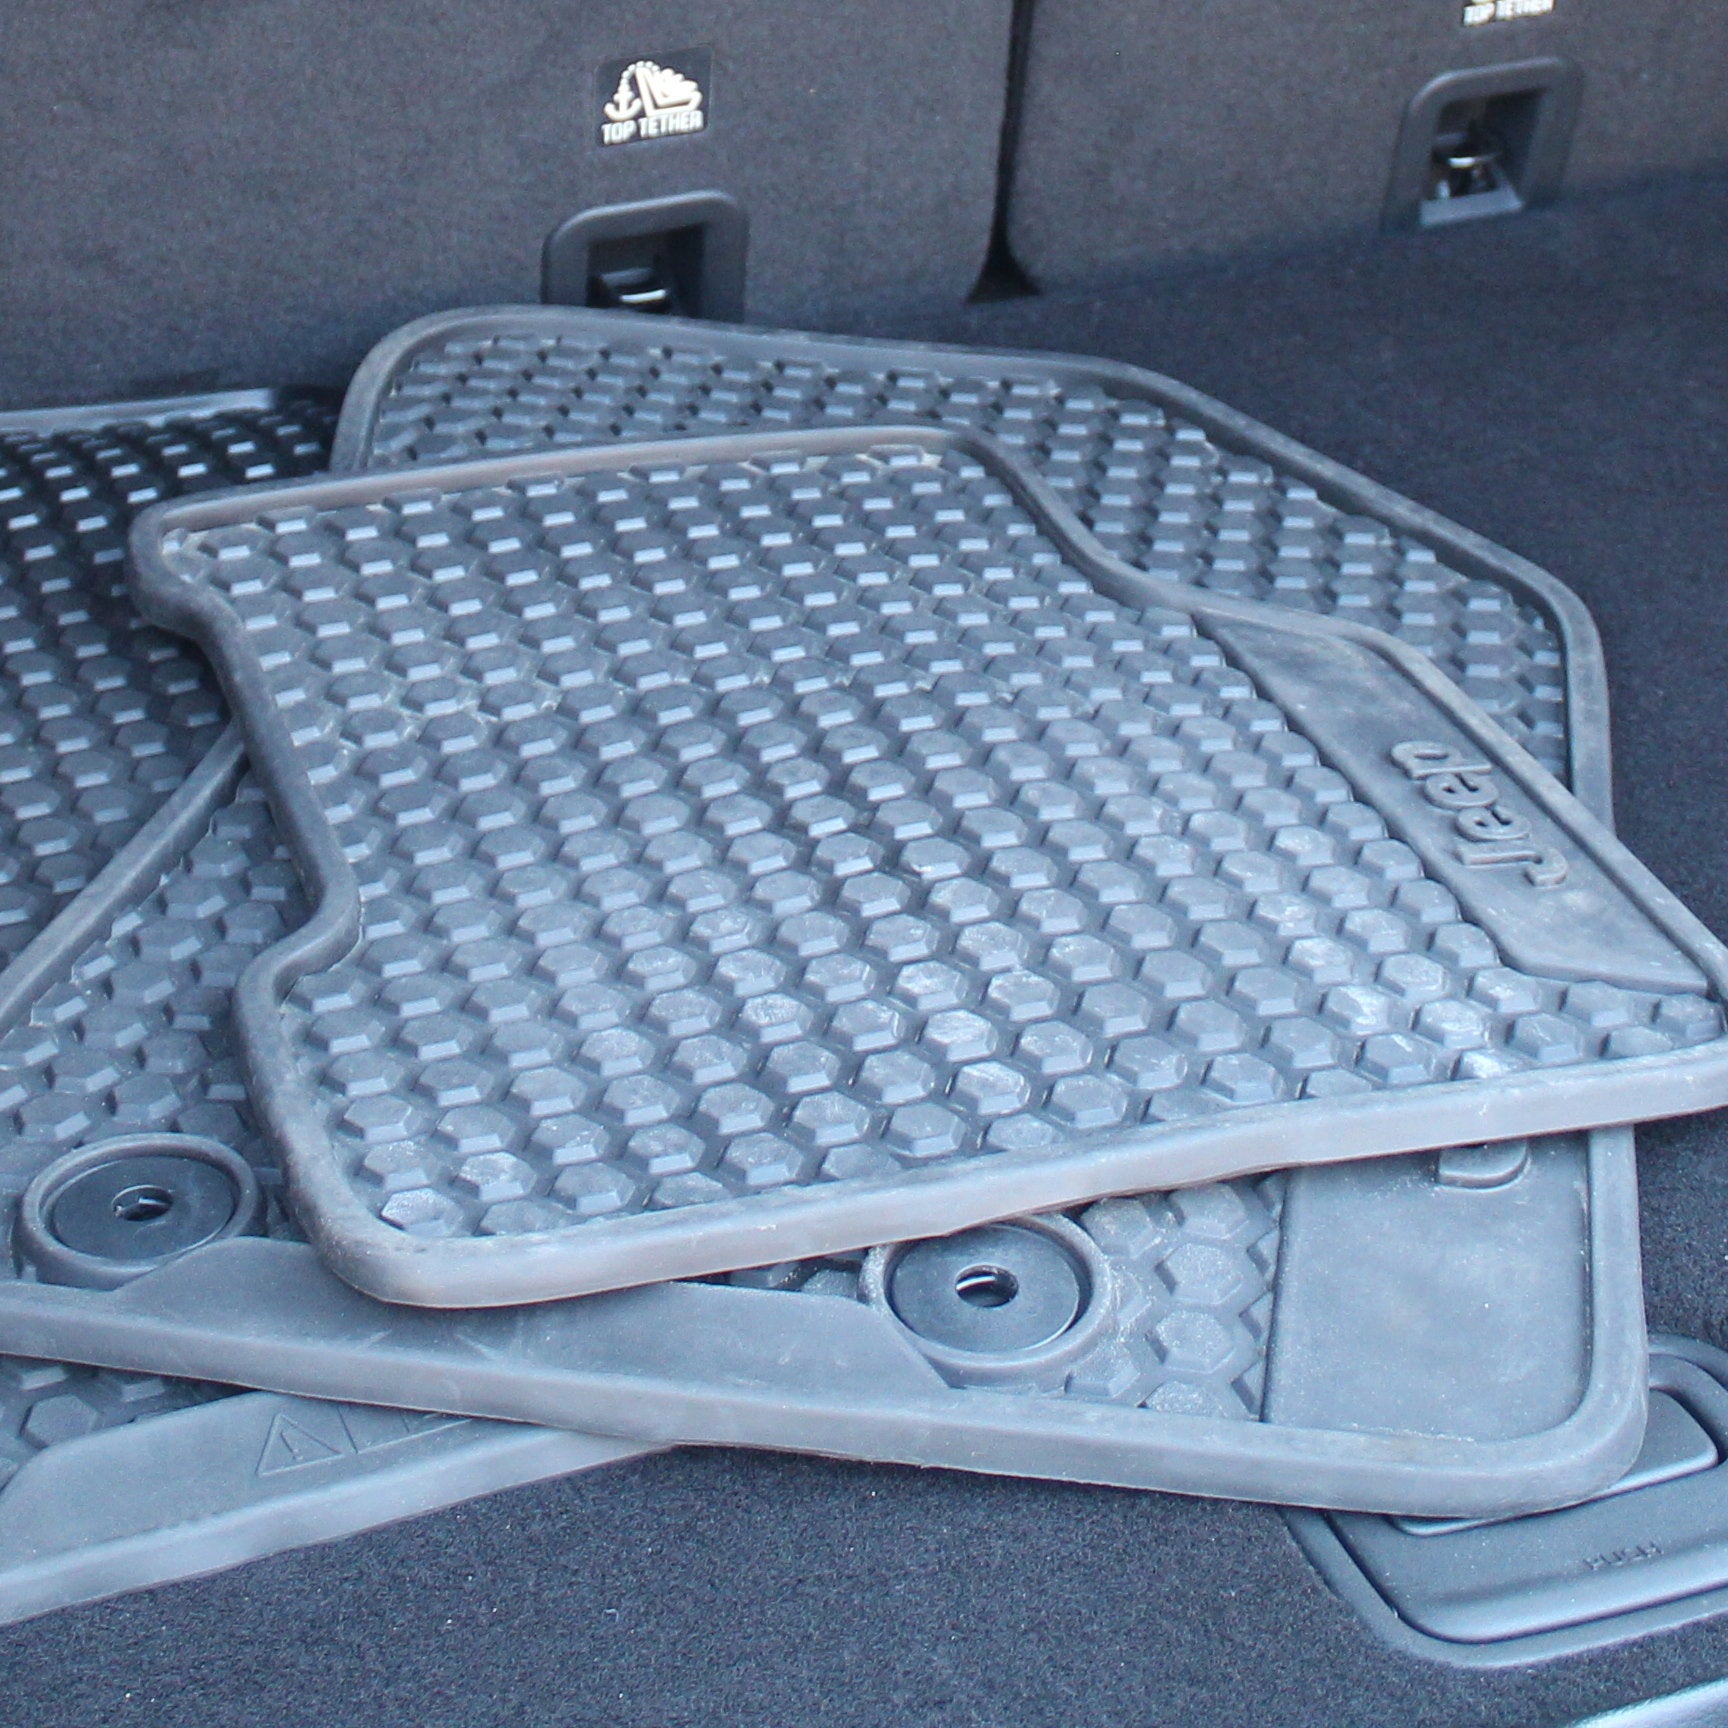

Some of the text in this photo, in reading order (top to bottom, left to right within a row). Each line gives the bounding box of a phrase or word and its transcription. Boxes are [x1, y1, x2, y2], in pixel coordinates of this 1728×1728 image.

[601, 110, 704, 145] TOP TETHER
[1390, 740, 1569, 888] Jeep
